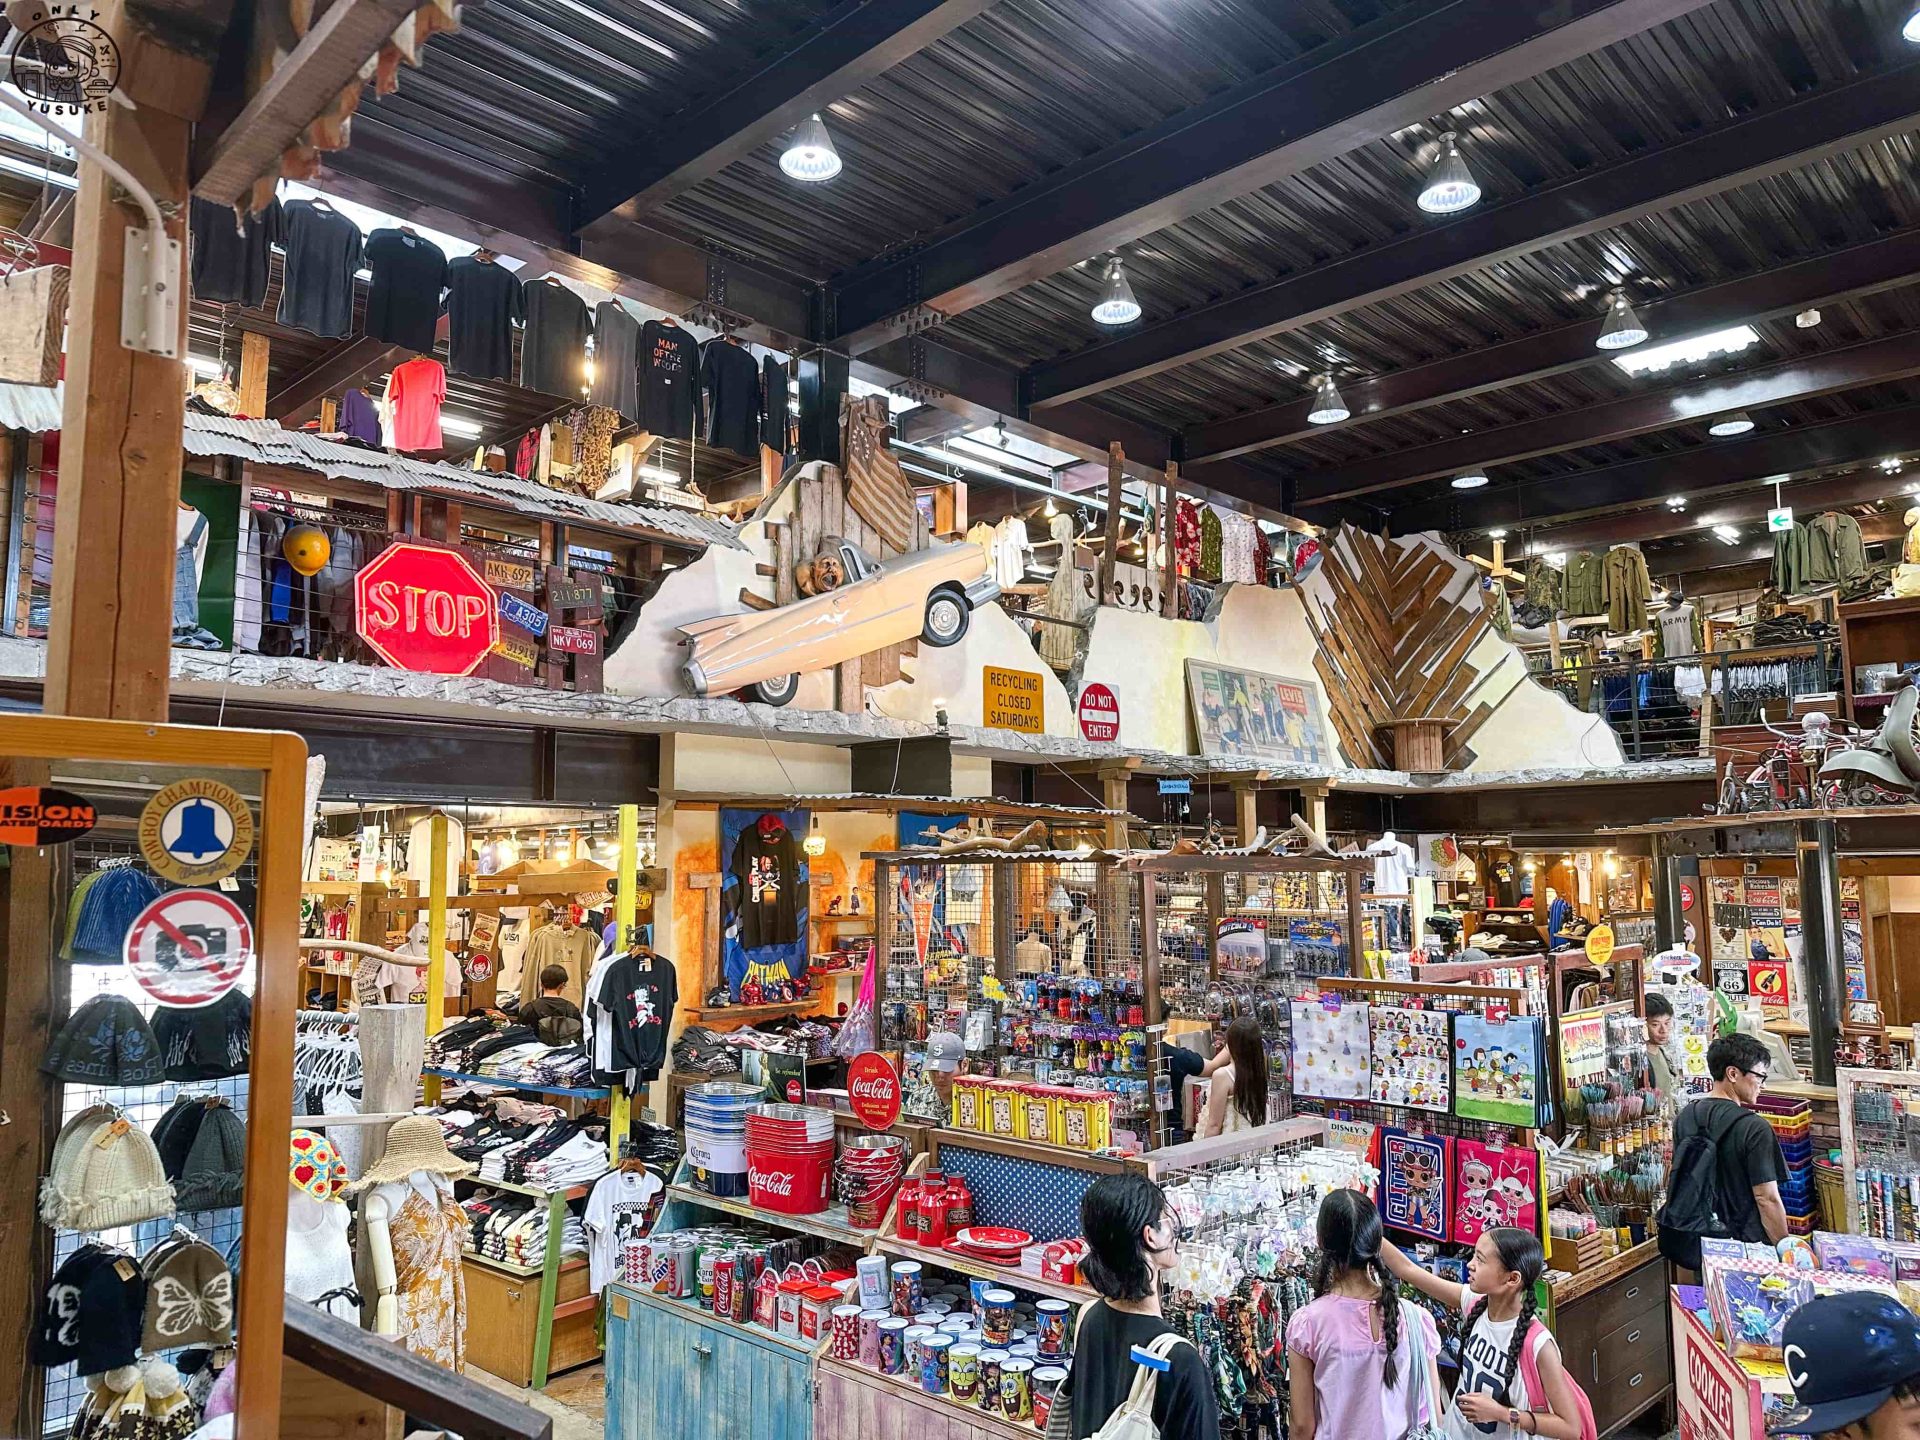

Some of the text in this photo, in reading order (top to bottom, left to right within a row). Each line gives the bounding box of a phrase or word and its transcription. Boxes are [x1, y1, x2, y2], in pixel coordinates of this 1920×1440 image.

[658, 337, 678, 351] MAN
[368, 580, 487, 639] STOP
[515, 608, 543, 628] A305
[1661, 616, 1689, 628] ARMY
[553, 634, 594, 650] NKV 069
[990, 672, 1038, 692] RECYCLING
[997, 695, 1031, 711] CLOSED
[1085, 693, 1112, 709] DO NOT
[990, 710, 1039, 729] SATURDAYS
[1088, 724, 1112, 739] ENTER
[156, 781, 244, 813] CHAMPIONS
[0, 804, 94, 821] ISION
[142, 810, 170, 869] COWBOY
[230, 813, 252, 857] WEAR
[1714, 962, 1746, 970] HISTORIC
[1723, 981, 1740, 990] 66
[864, 1066, 878, 1074] Drink
[852, 1076, 893, 1100] Coca-Cola
[1331, 1123, 1368, 1135] DISNEY'S
[690, 1145, 711, 1160] Corona
[748, 1166, 795, 1196] Coca-Cola
[1390, 1140, 1408, 1218] GLITTER
[1784, 1344, 1809, 1388] C
[1689, 1346, 1731, 1430] COOKIES
